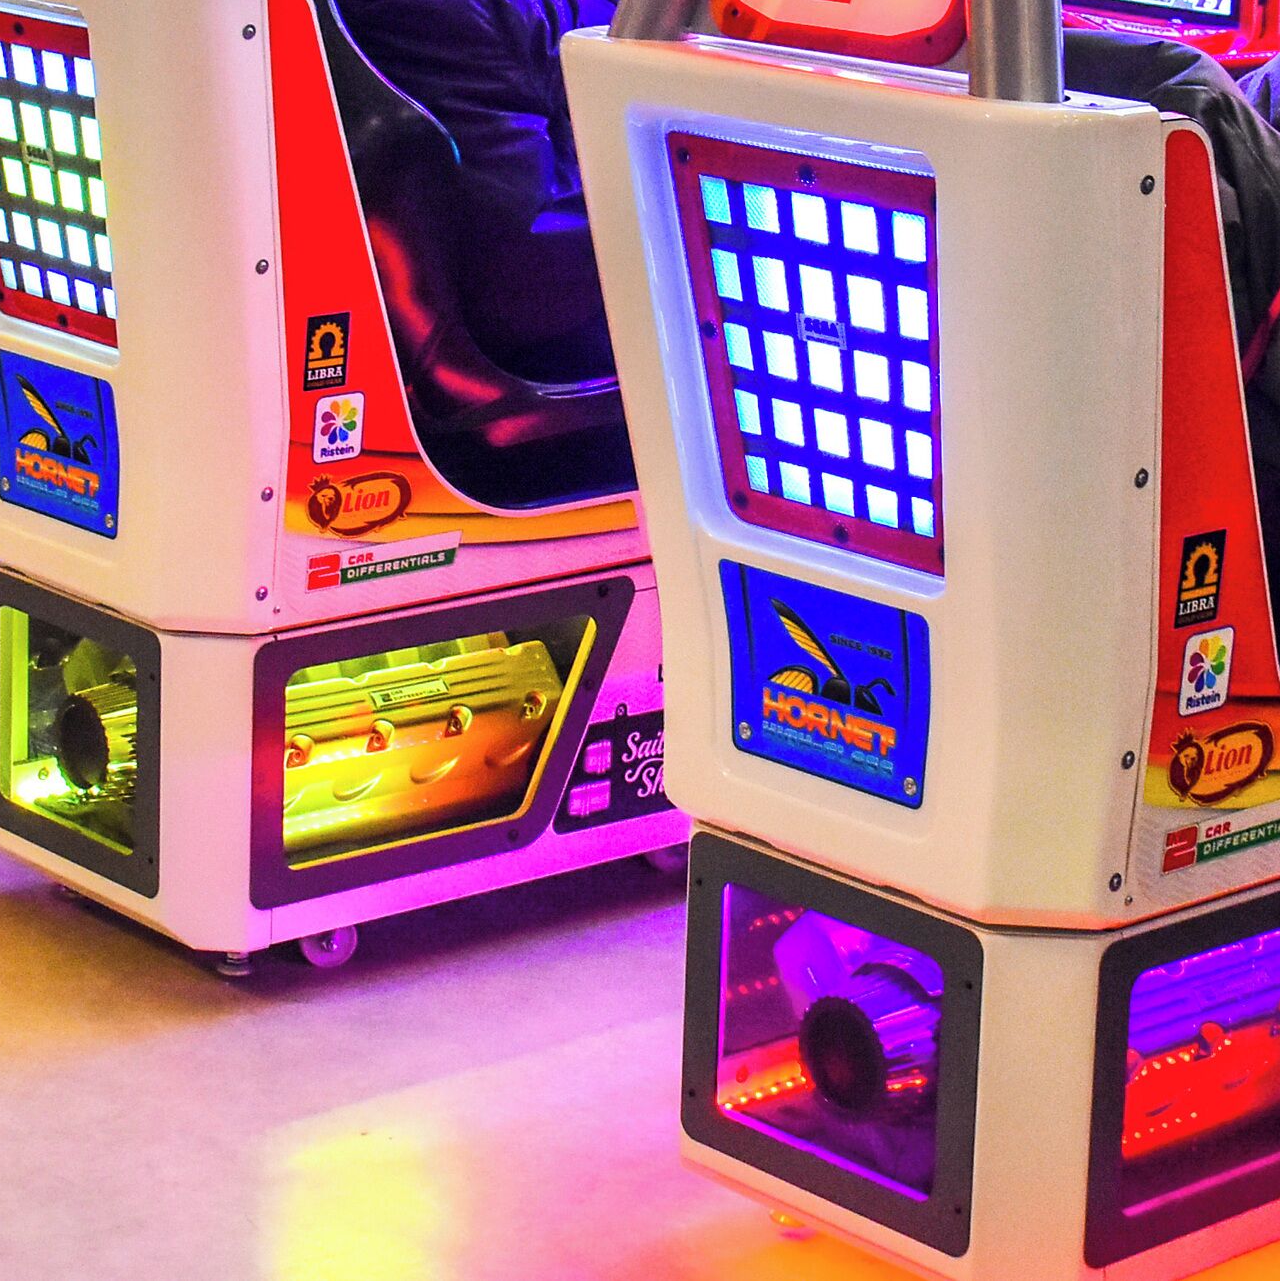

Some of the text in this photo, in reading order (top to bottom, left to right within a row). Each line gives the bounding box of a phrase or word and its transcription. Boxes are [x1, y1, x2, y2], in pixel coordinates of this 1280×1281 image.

[307, 366, 344, 382] LIBRA
[320, 444, 355, 458] Ristein
[15, 448, 100, 498] HORNET
[341, 489, 390, 514] Lion
[346, 552, 446, 580] DIFFERENTIALS
[348, 552, 375, 566] CAR
[1178, 596, 1216, 617] LIBRA
[1185, 691, 1221, 711] Ristein
[762, 686, 897, 757] HORNET
[1204, 742, 1254, 776] Lion
[1205, 820, 1232, 839] CAR
